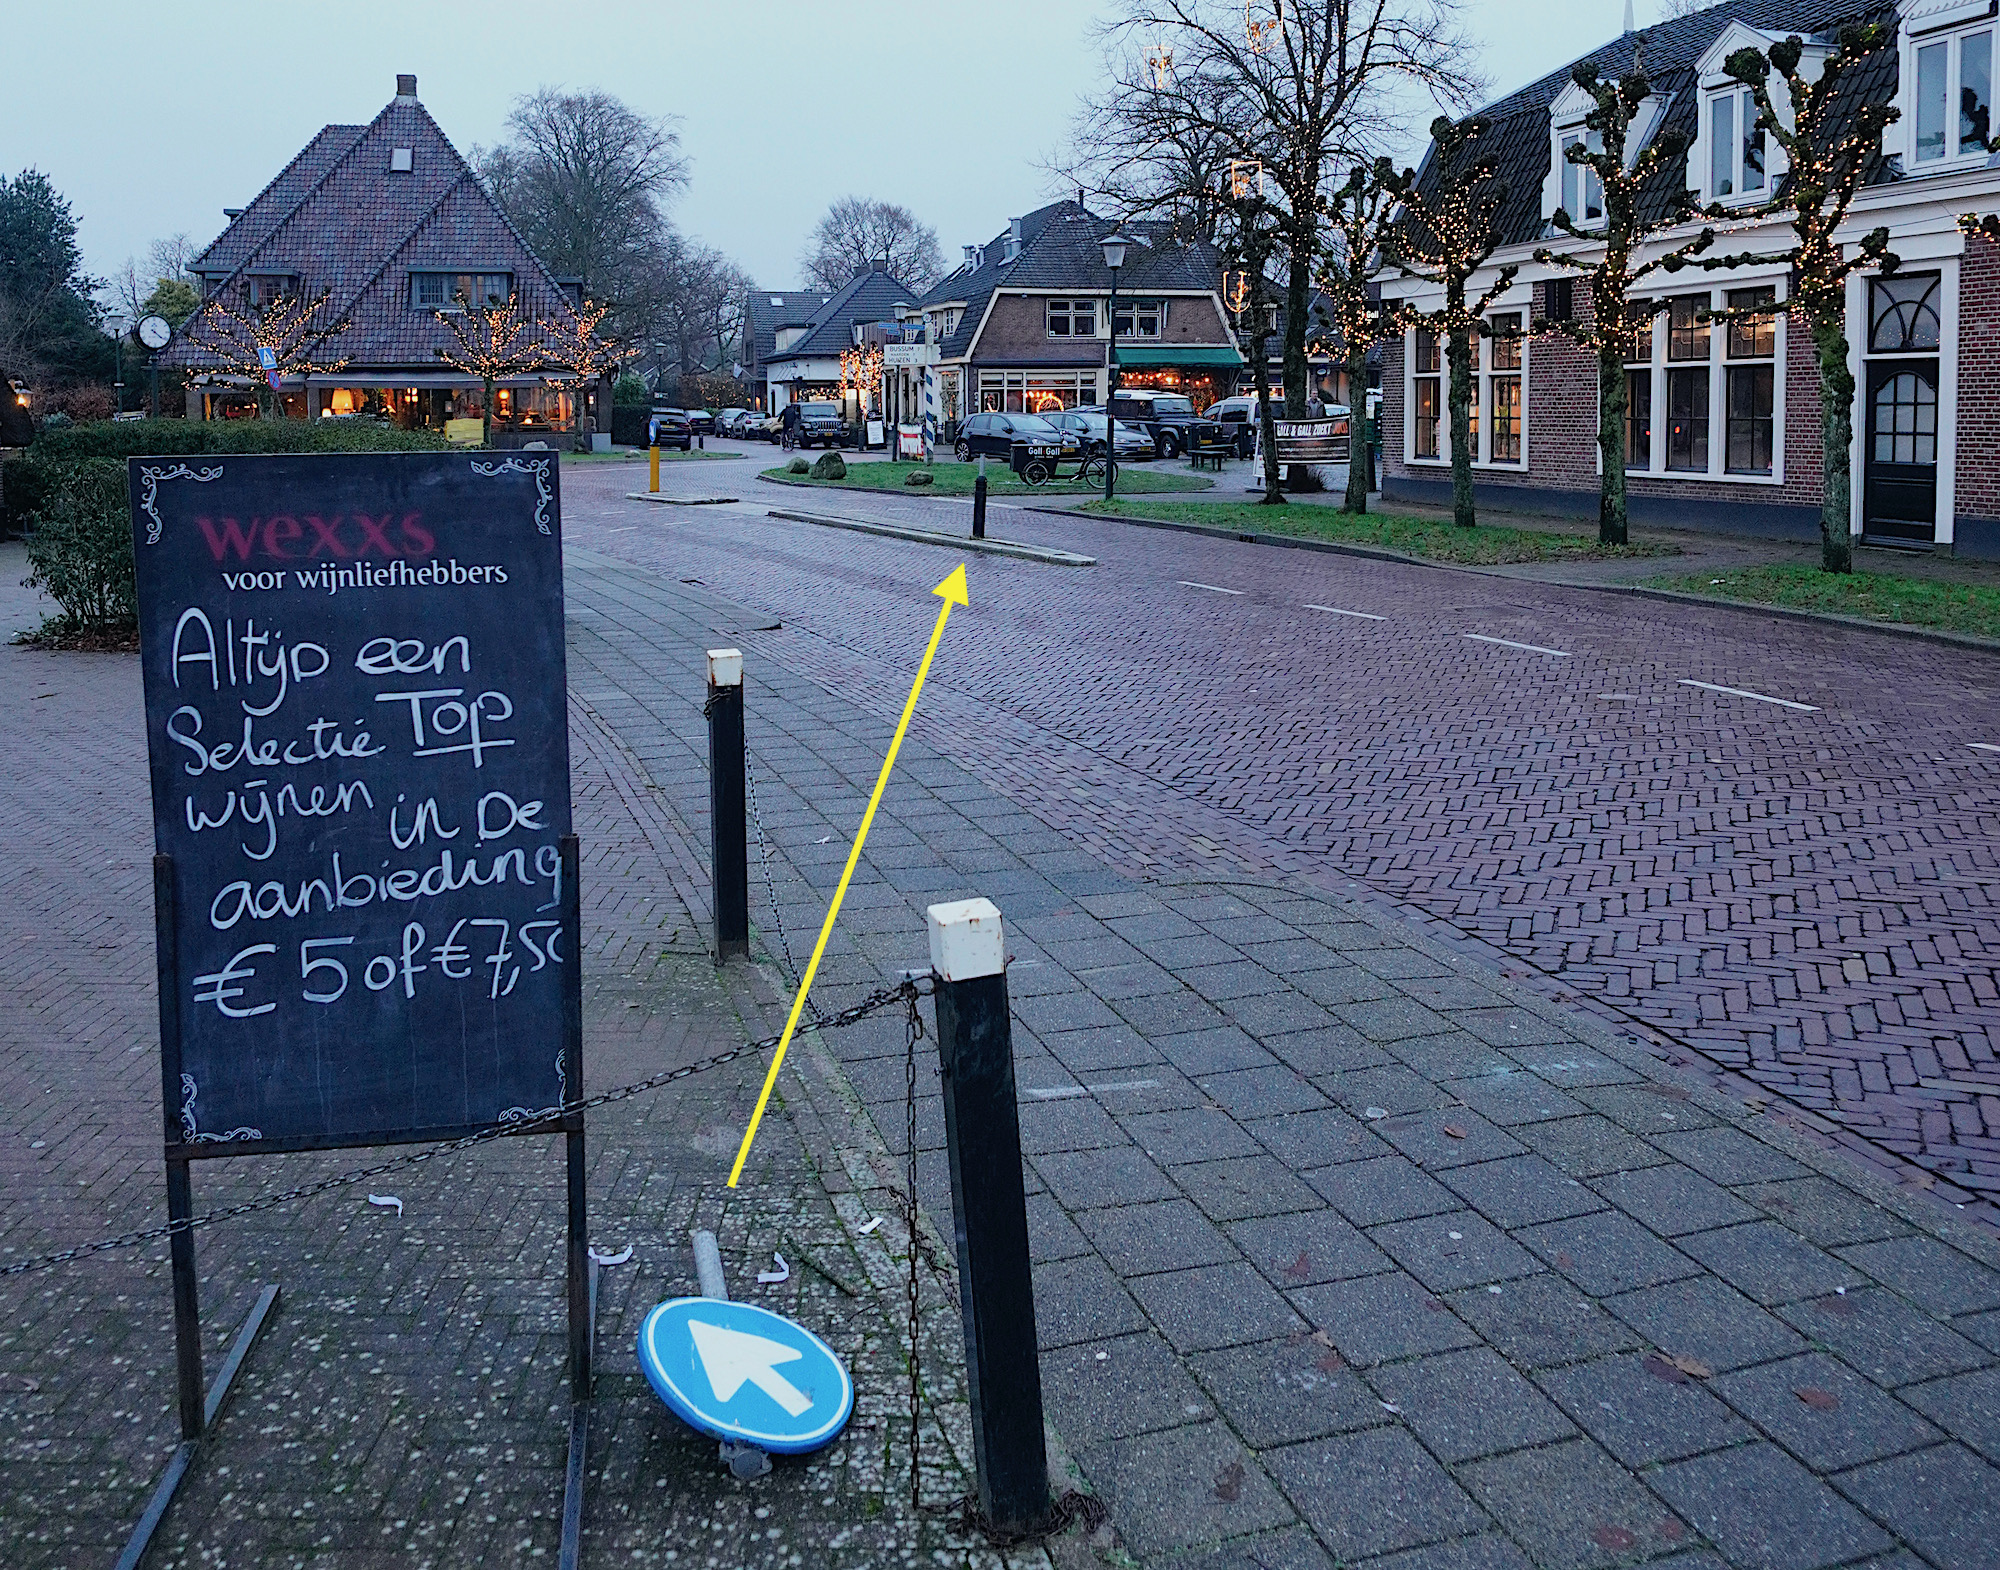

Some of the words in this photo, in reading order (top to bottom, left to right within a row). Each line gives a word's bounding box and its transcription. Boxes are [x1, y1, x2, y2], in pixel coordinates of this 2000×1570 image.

[1028, 446, 1043, 456] Gall
[1045, 446, 1061, 456] Gall
[1297, 423, 1312, 437] GALL
[1313, 422, 1333, 436] ZOEKT
[197, 511, 436, 562] wexxs
[223, 567, 286, 591] voor
[295, 559, 509, 596] wijnliefhebbers
[355, 635, 471, 675] een
[390, 793, 461, 852] in
[477, 789, 550, 842] De
[210, 843, 563, 931] aanbieding
[300, 936, 354, 1004] 5
[362, 921, 428, 1000] of
